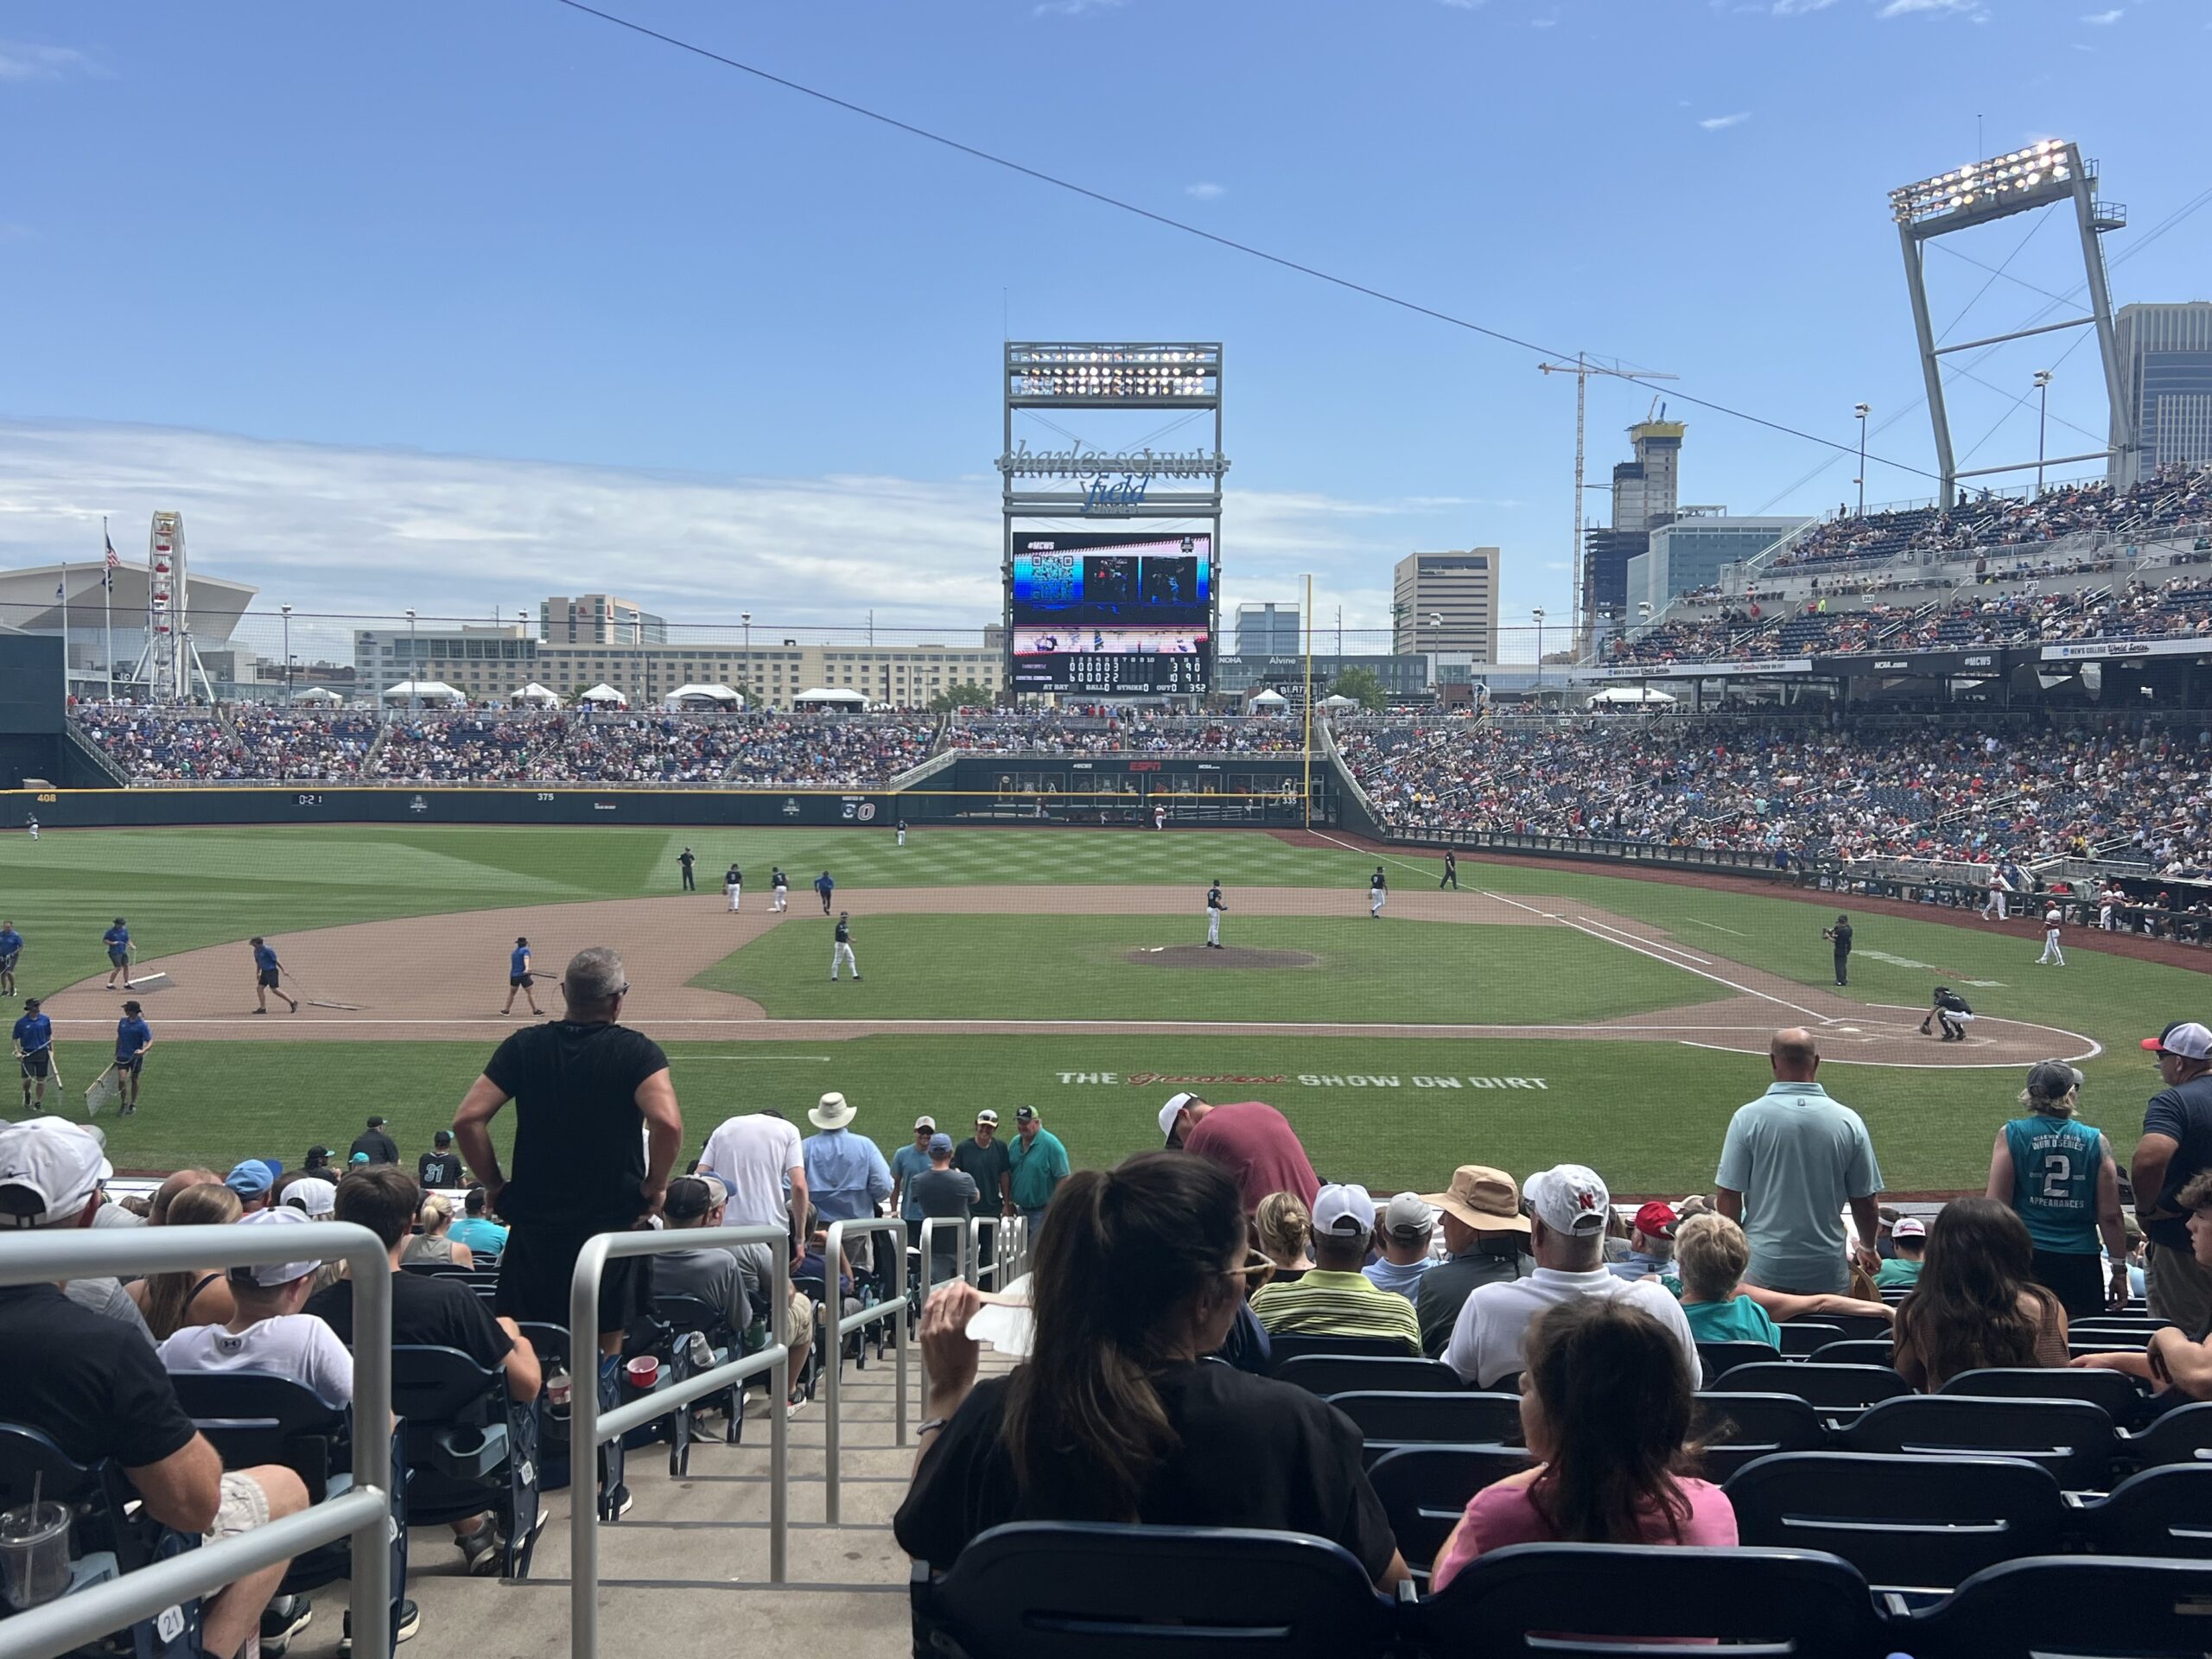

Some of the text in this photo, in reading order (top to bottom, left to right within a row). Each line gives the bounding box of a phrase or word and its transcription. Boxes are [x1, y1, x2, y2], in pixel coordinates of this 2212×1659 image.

[998, 439, 1226, 473] charles SCHWAB
[1080, 474, 1151, 512] field
[1027, 542, 1054, 550] #MCWS
[2107, 645, 2127, 653] World
[2128, 643, 2150, 652] Series
[1268, 656, 1296, 664] Alvine
[1964, 656, 1991, 667] #MCWS
[1070, 663, 1200, 671] 0 0 0 0 0 3 3 9 0
[1070, 672, 1075, 682] 6
[1078, 672, 1084, 682] 0
[1087, 672, 1092, 682] 0
[1096, 672, 1101, 682] 0
[1104, 672, 1109, 682] 2
[1113, 672, 1118, 682] 2
[1170, 672, 1178, 682] 10
[1185, 672, 1192, 682] 9
[1197, 672, 1200, 682] 1
[1280, 685, 1307, 695] BLAT
[1129, 762, 1161, 771] ESPN
[37, 793, 56, 803] 408
[537, 792, 555, 801] 375
[1055, 1071, 1549, 1090] THE Greatest SHOW ON DIRT
[2032, 1141, 2084, 1152] WORLD SERIES
[424, 1164, 444, 1183] 31
[2044, 1155, 2070, 1197] 2
[1579, 1192, 1595, 1211] N
[2029, 1196, 2085, 1209] APPEARANCES
[163, 1611, 180, 1637] 21
